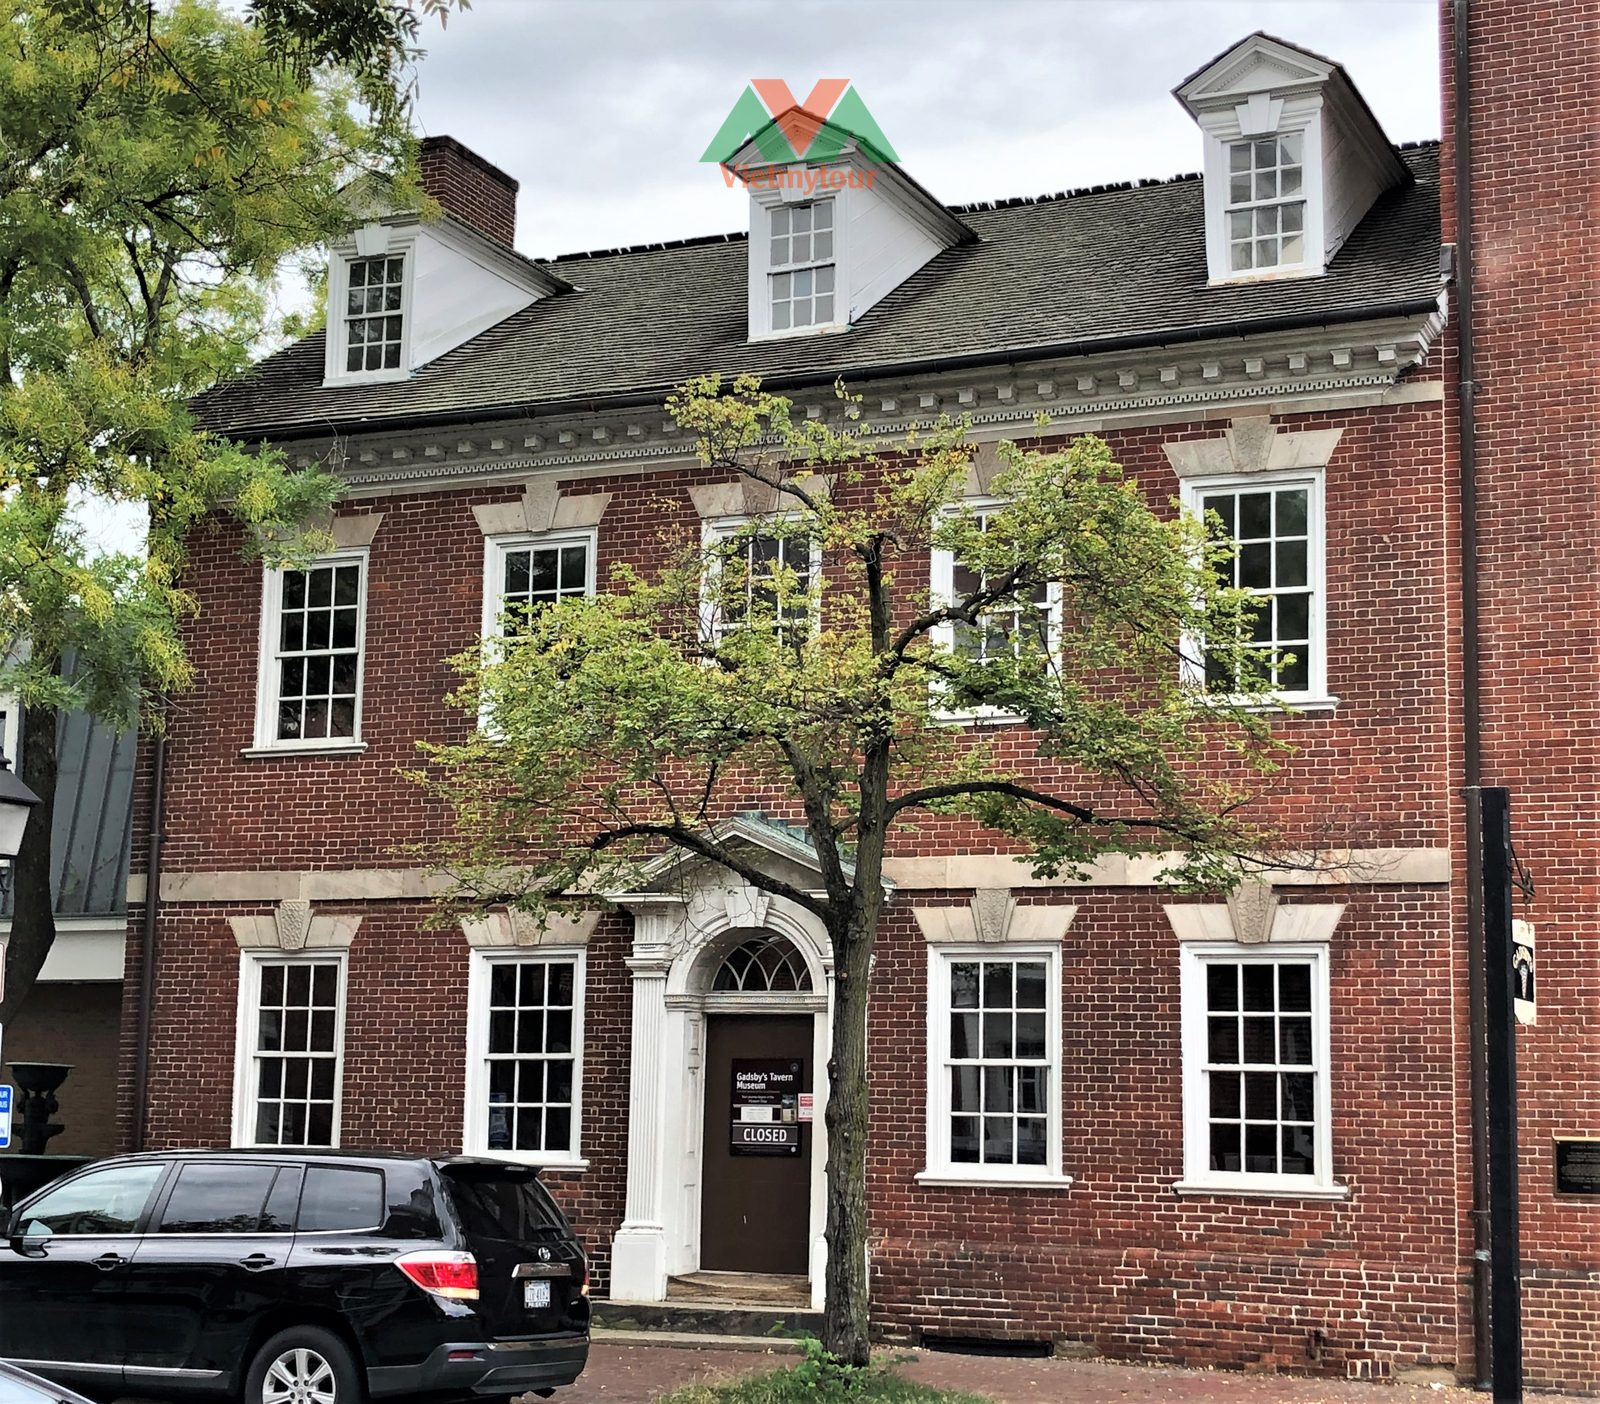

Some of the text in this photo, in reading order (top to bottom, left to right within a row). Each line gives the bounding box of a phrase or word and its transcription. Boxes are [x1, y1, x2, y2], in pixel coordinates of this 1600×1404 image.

[736, 1072, 793, 1082] Gadsby's Tavern
[736, 1081, 766, 1089] Museum
[743, 1128, 787, 1142] CLOSED
